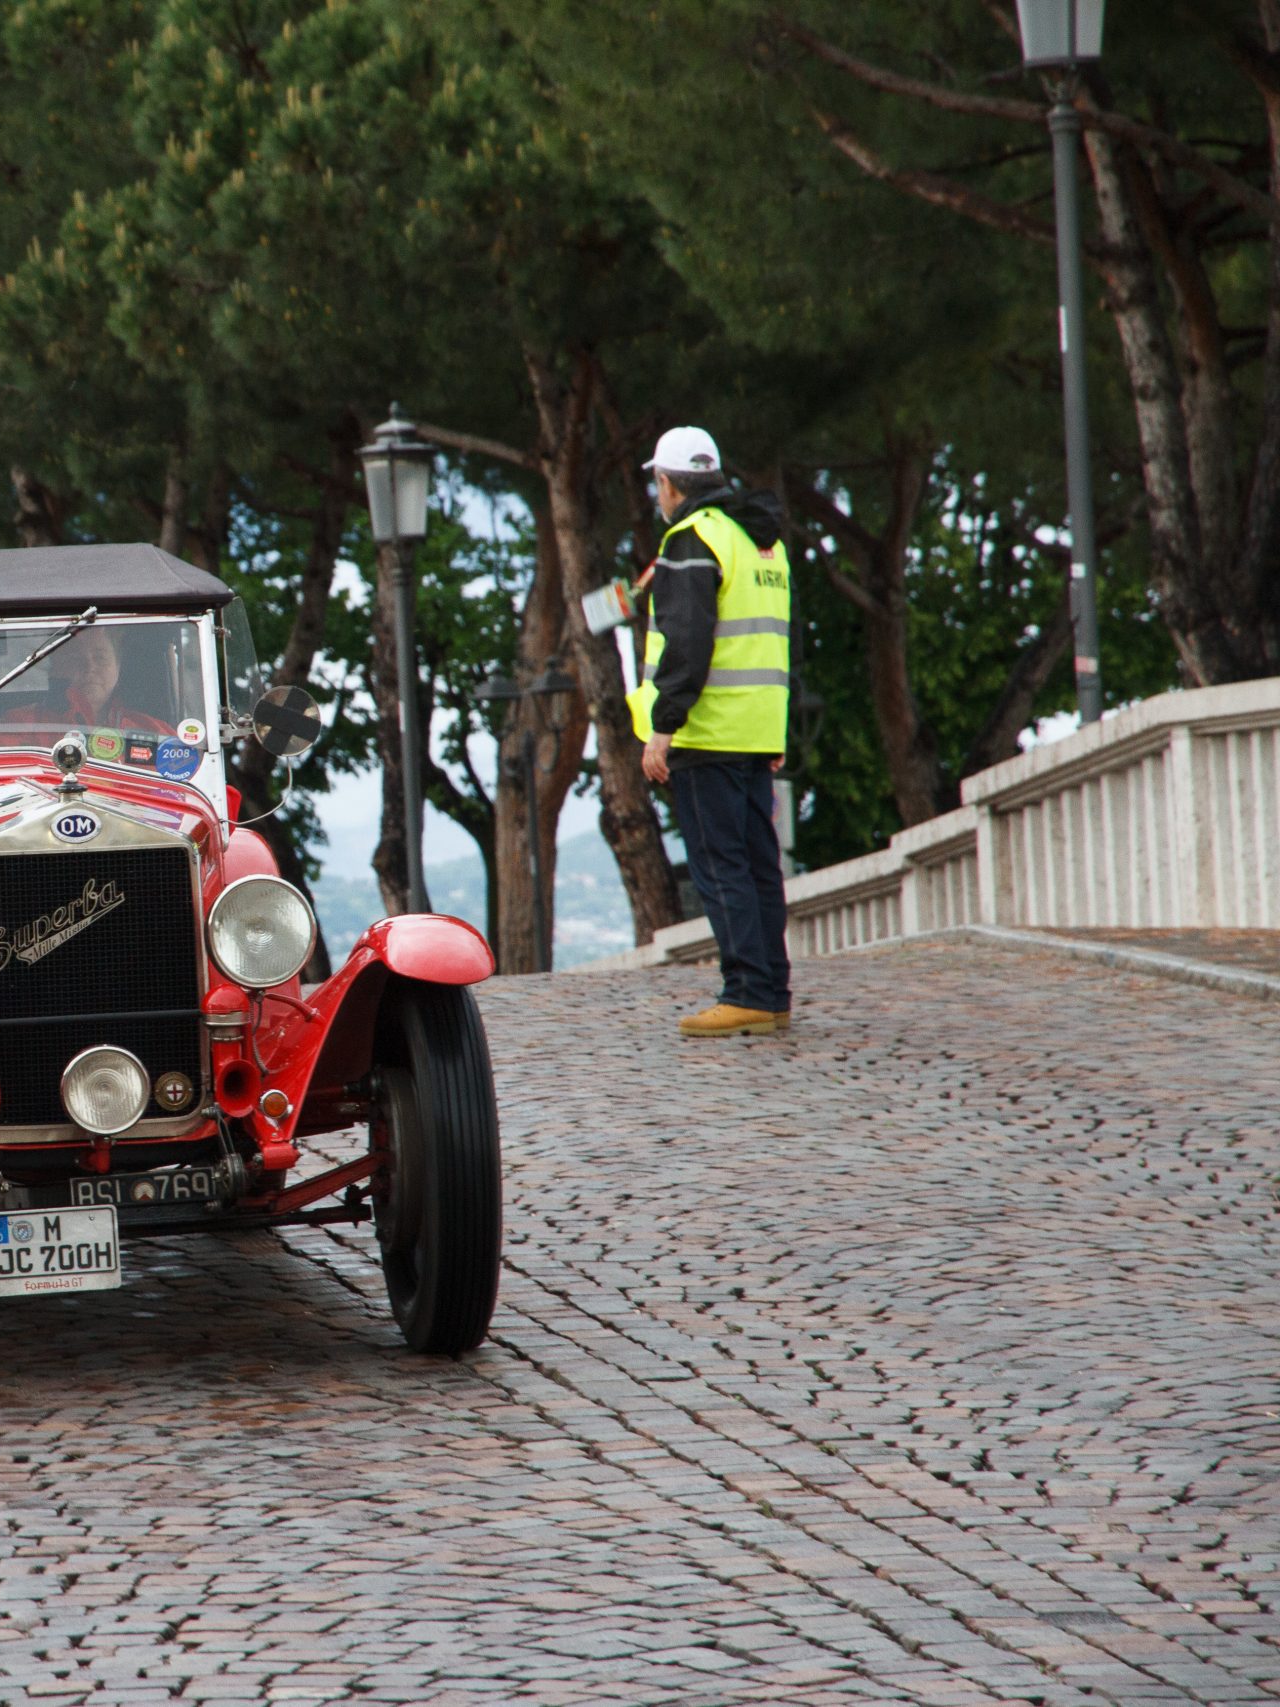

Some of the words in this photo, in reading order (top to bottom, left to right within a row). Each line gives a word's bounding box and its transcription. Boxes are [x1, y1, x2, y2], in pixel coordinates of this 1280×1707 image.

[162, 748, 190, 759] 2008
[163, 771, 191, 780] PASSED
[60, 817, 92, 835] OM
[43, 1215, 61, 1242] M
[71, 1276, 84, 1289] GT
